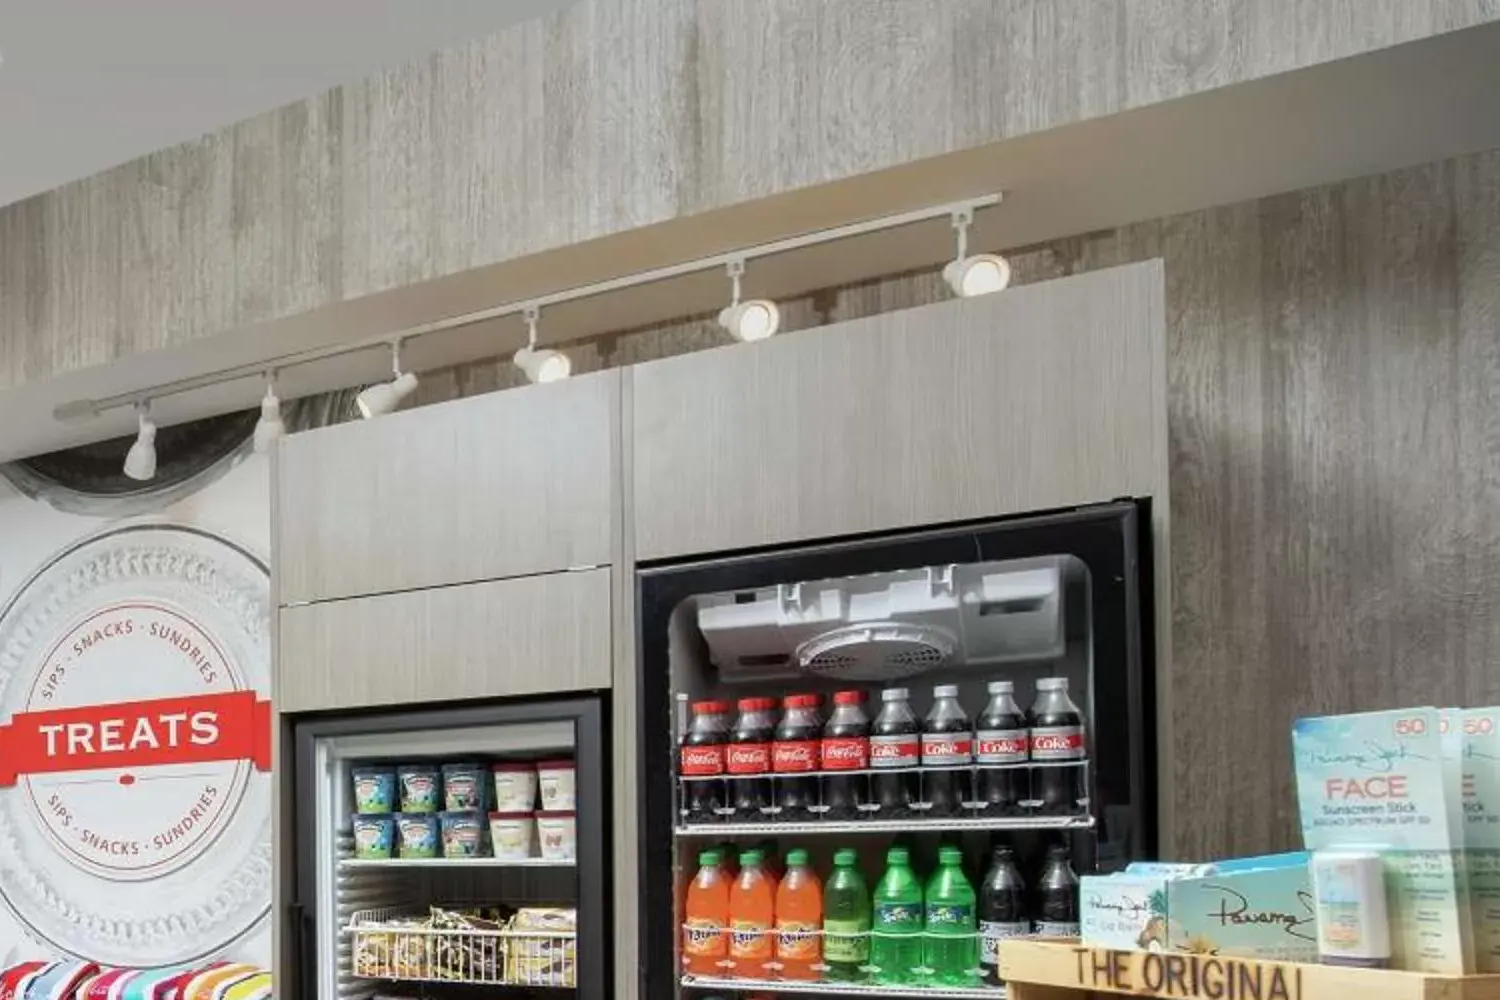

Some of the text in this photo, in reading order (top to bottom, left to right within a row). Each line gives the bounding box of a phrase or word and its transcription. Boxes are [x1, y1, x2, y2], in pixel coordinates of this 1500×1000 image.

[42, 619, 218, 701] SIPS SNACKS SUNDRIES
[38, 710, 220, 757] TREATS
[1034, 735, 1071, 749] Coke
[1395, 718, 1426, 734] 50
[924, 742, 958, 756] Coke
[1325, 774, 1409, 800] FACE
[47, 784, 219, 856] SIPS SNACKS SUNDRIES
[1321, 801, 1418, 816] Sunscreen Stick
[1201, 882, 1301, 928] Panama
[1072, 947, 1134, 991] THE
